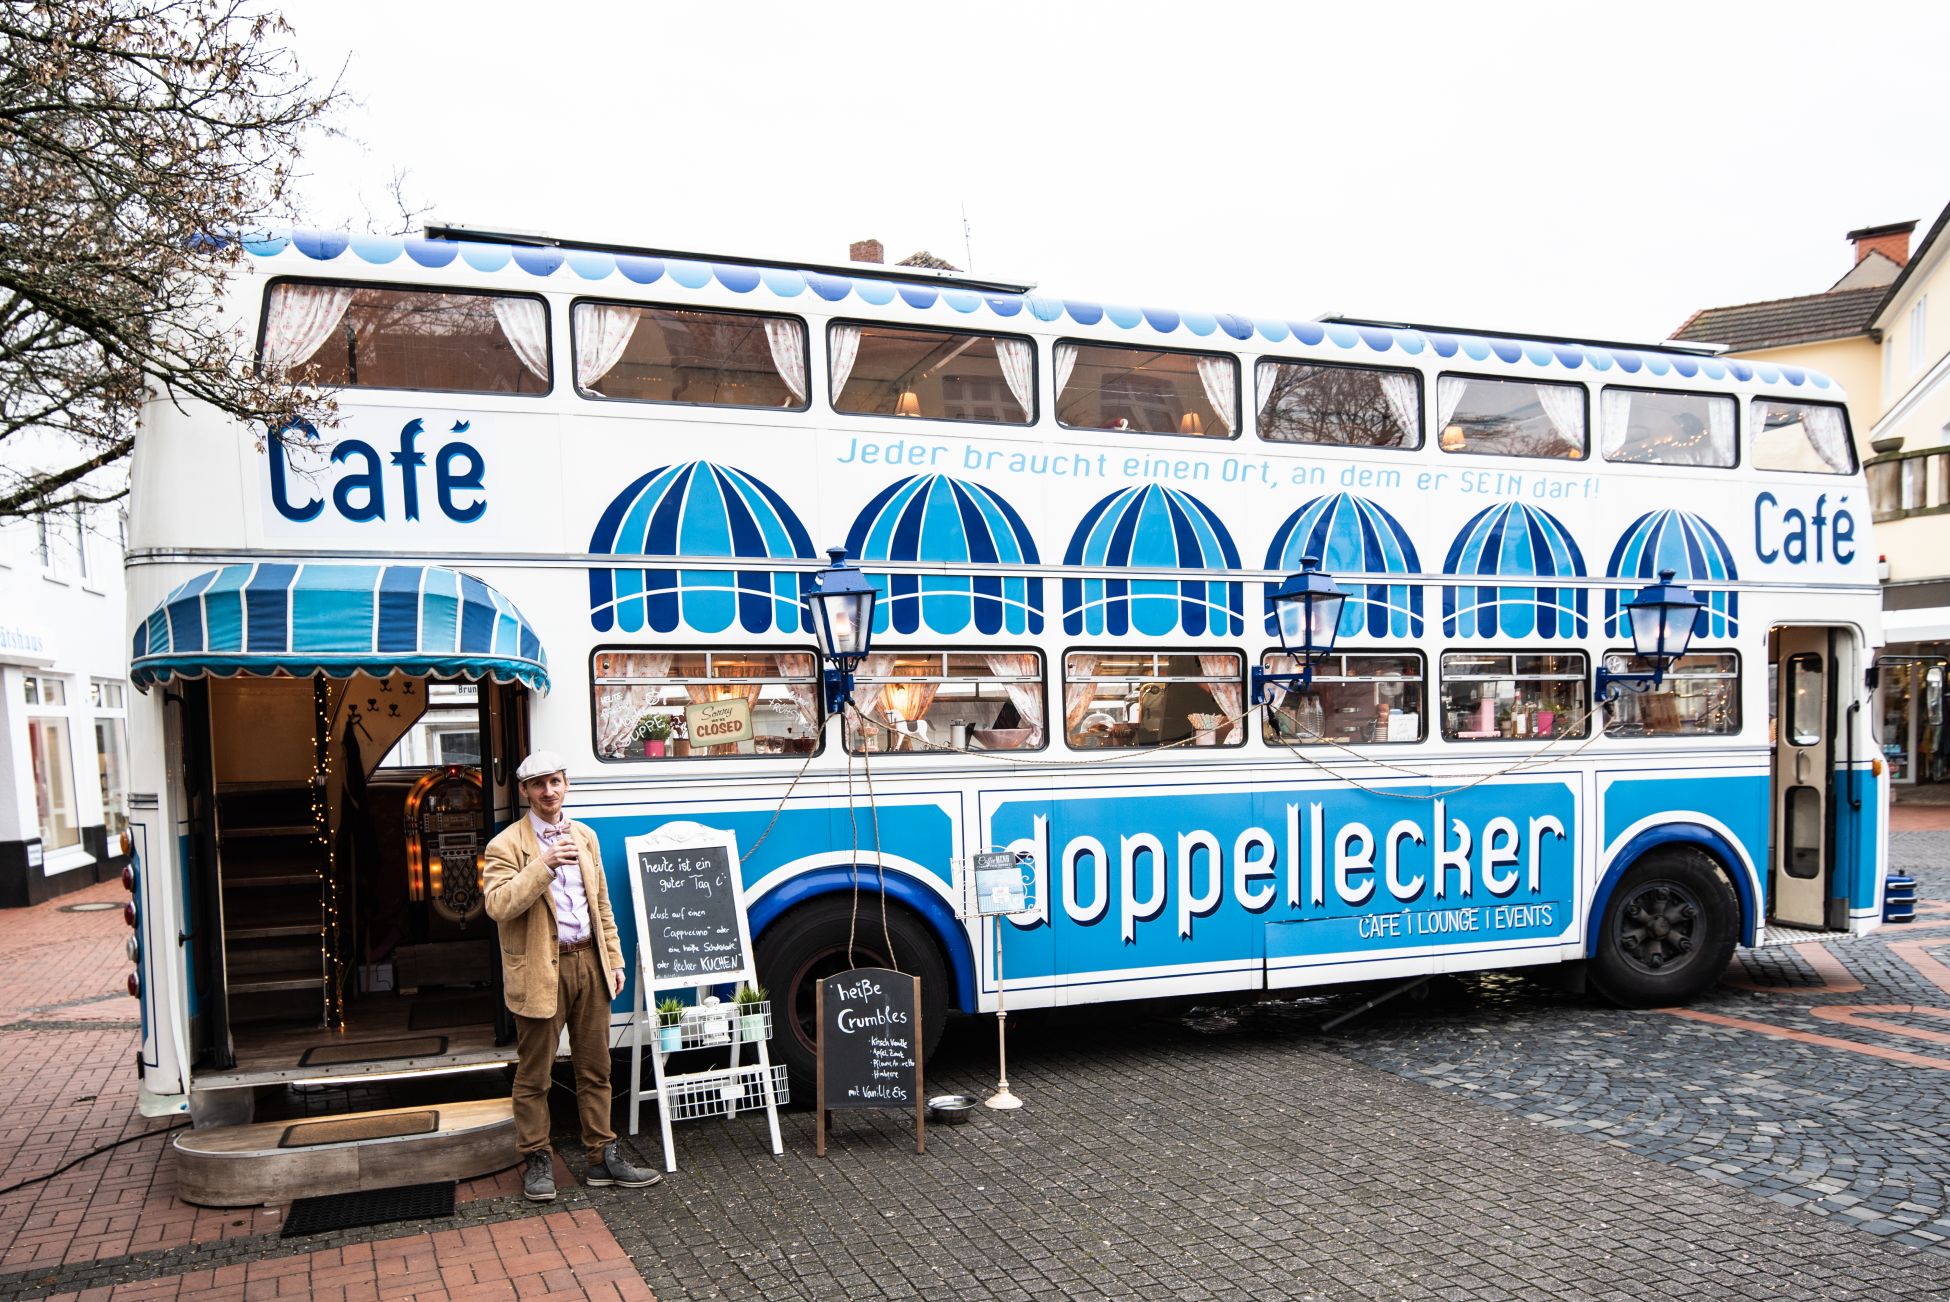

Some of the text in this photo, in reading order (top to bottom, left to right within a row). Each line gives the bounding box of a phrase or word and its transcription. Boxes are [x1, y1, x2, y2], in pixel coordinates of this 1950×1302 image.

[267, 414, 488, 524] Café
[836, 437, 1600, 500] Jeder braucht einen Ort, an dem er SEIN darf!
[1754, 491, 1856, 566] Café
[701, 706, 733, 721] Sorry
[696, 720, 743, 738] CLOSED
[642, 857, 711, 873] heute ist ein
[1000, 797, 1567, 947] doppellecker
[659, 874, 712, 898] guter Tag
[650, 906, 706, 920] Lust auf einen
[1418, 908, 1479, 935] LOUNGE
[1495, 904, 1553, 929] EVENTS
[700, 954, 738, 971] KUCHEN
[837, 979, 882, 1004] heiße
[837, 1005, 908, 1034] Crumbles
[848, 1084, 907, 1101] mit Vanille Eis
